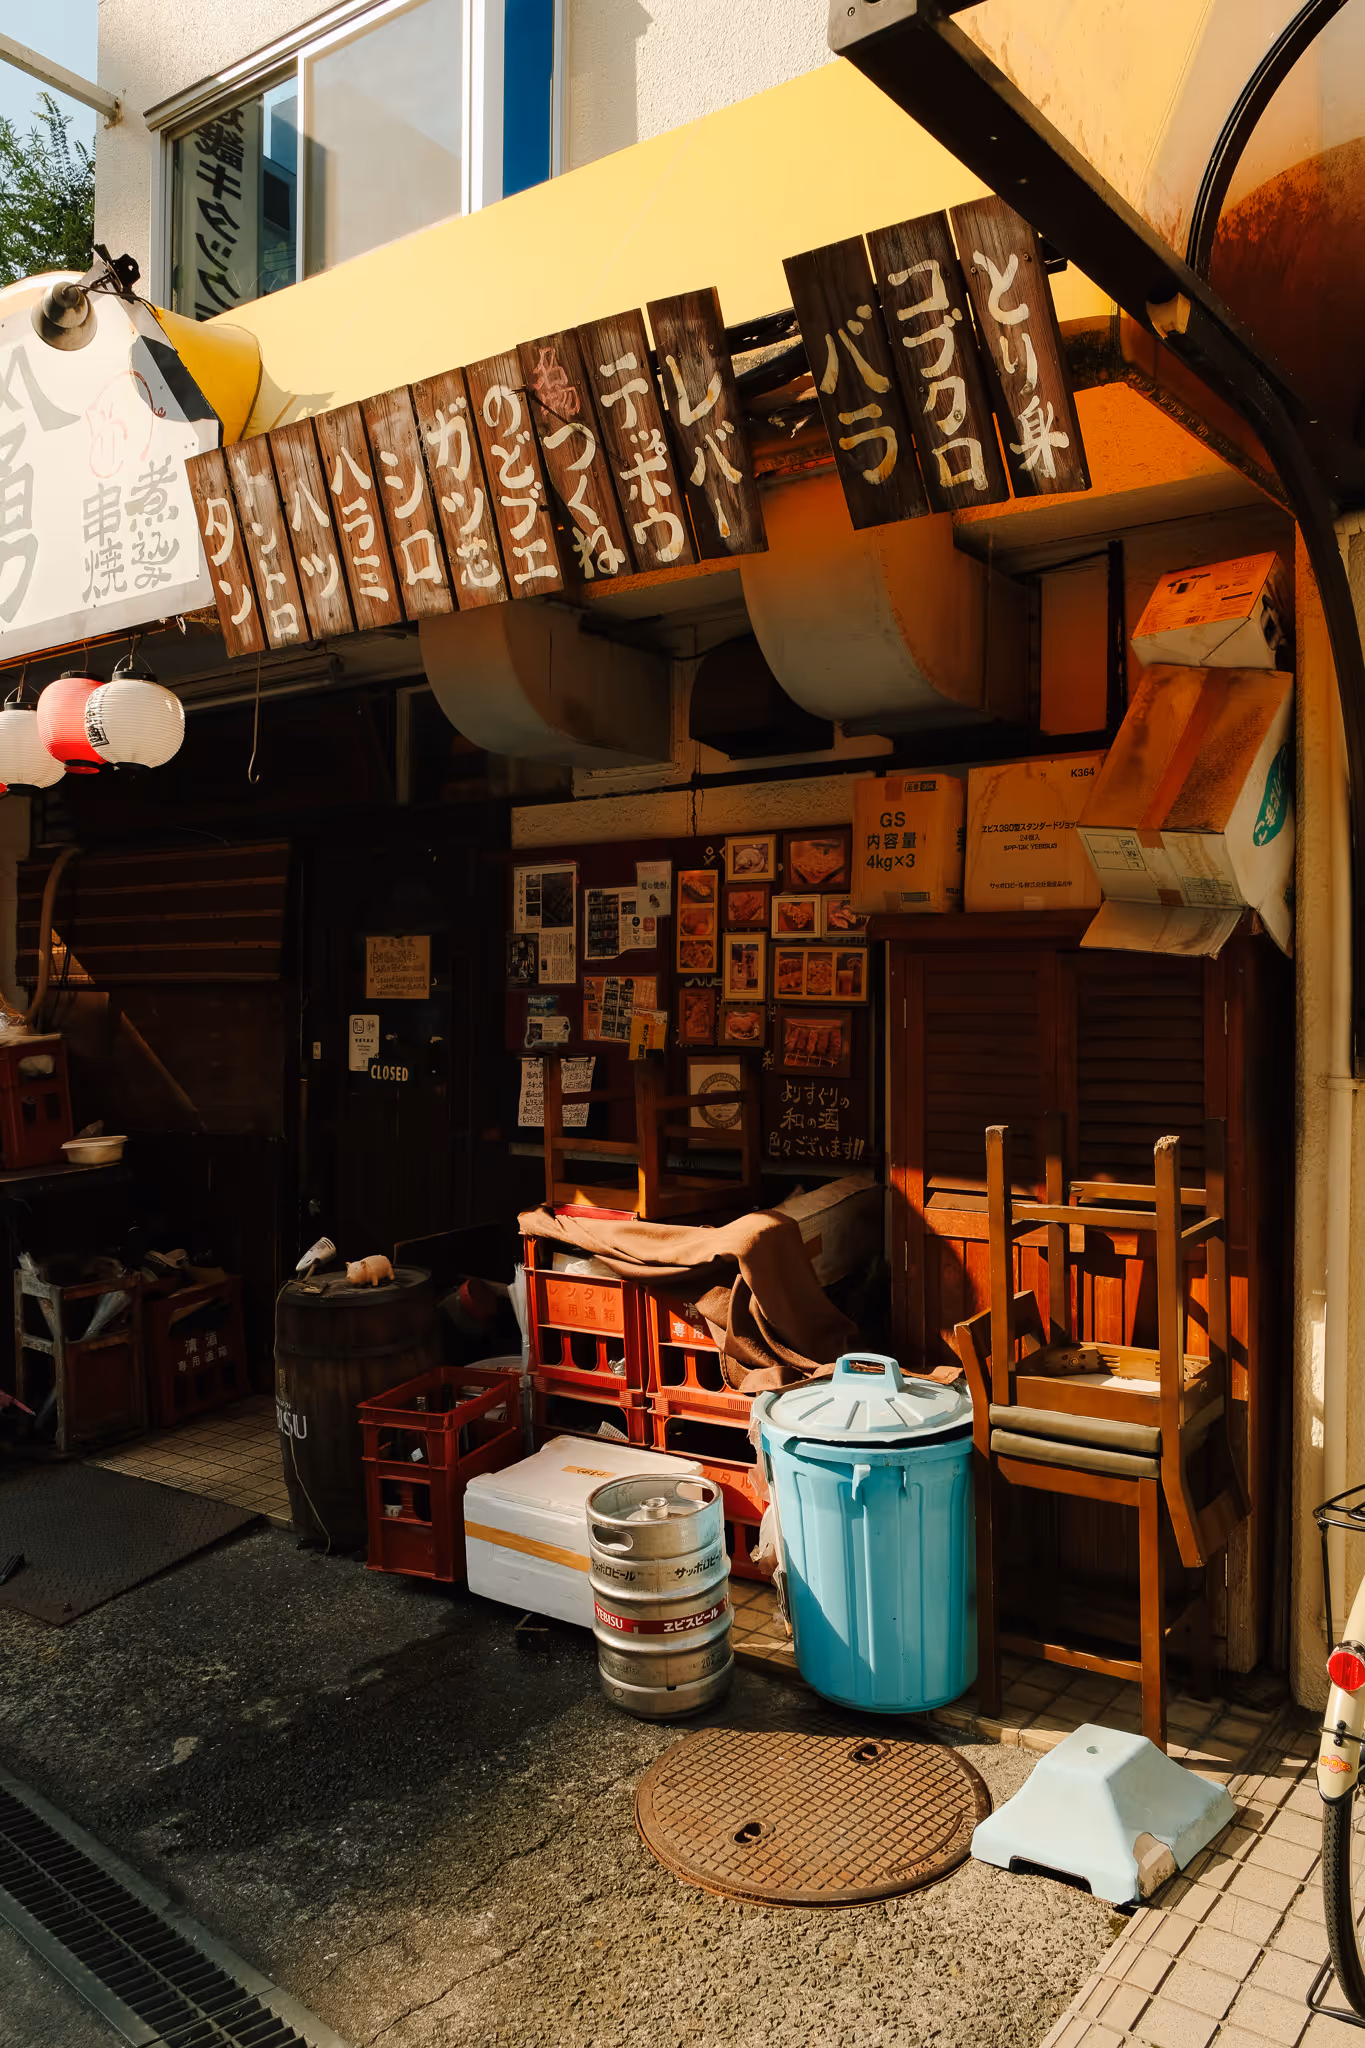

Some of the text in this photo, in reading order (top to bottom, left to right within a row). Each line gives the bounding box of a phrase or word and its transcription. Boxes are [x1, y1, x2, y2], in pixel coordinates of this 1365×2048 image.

[820, 304, 898, 485] バラ
[888, 260, 988, 490] コブクロ
[973, 250, 1069, 479] とり身
[483, 384, 558, 585] のどブエ
[599, 352, 685, 563] テッポウ
[666, 355, 743, 538] レバー
[82, 481, 128, 604] 串焼
[124, 454, 180, 590] 煮込み
[205, 497, 251, 625] タン
[236, 457, 299, 638] トントロ
[292, 477, 339, 599] ハツ
[331, 446, 389, 602] ハラミ
[380, 451, 442, 586] シロ
[880, 812, 906, 828] GS
[1071, 767, 1095, 777] K364
[867, 832, 917, 850] 内容量
[371, 1064, 409, 1081] CLOSED
[780, 1080, 850, 1108] よりすぐりの
[780, 1107, 840, 1131] 和の酒
[596, 1604, 623, 1629] YEBISU
